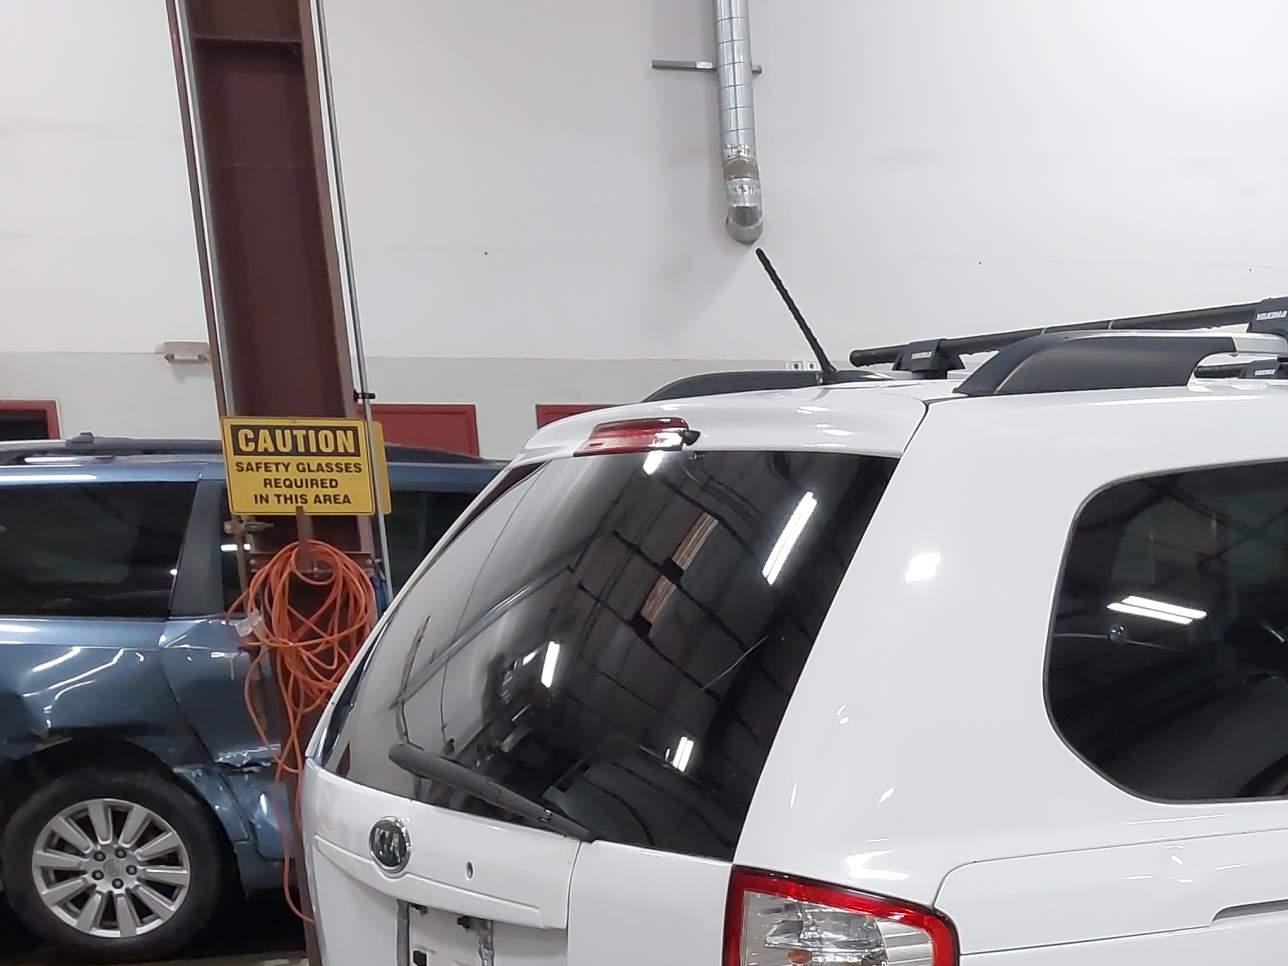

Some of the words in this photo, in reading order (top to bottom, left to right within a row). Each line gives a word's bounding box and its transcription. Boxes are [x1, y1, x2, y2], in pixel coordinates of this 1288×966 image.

[238, 429, 355, 453] CAUTION
[235, 461, 291, 473] SAFETY
[296, 462, 362, 473] GLASSES
[263, 477, 339, 489] REQUIRED
[254, 493, 270, 504] IN
[274, 494, 308, 505] THIS
[313, 494, 352, 505] AREA
